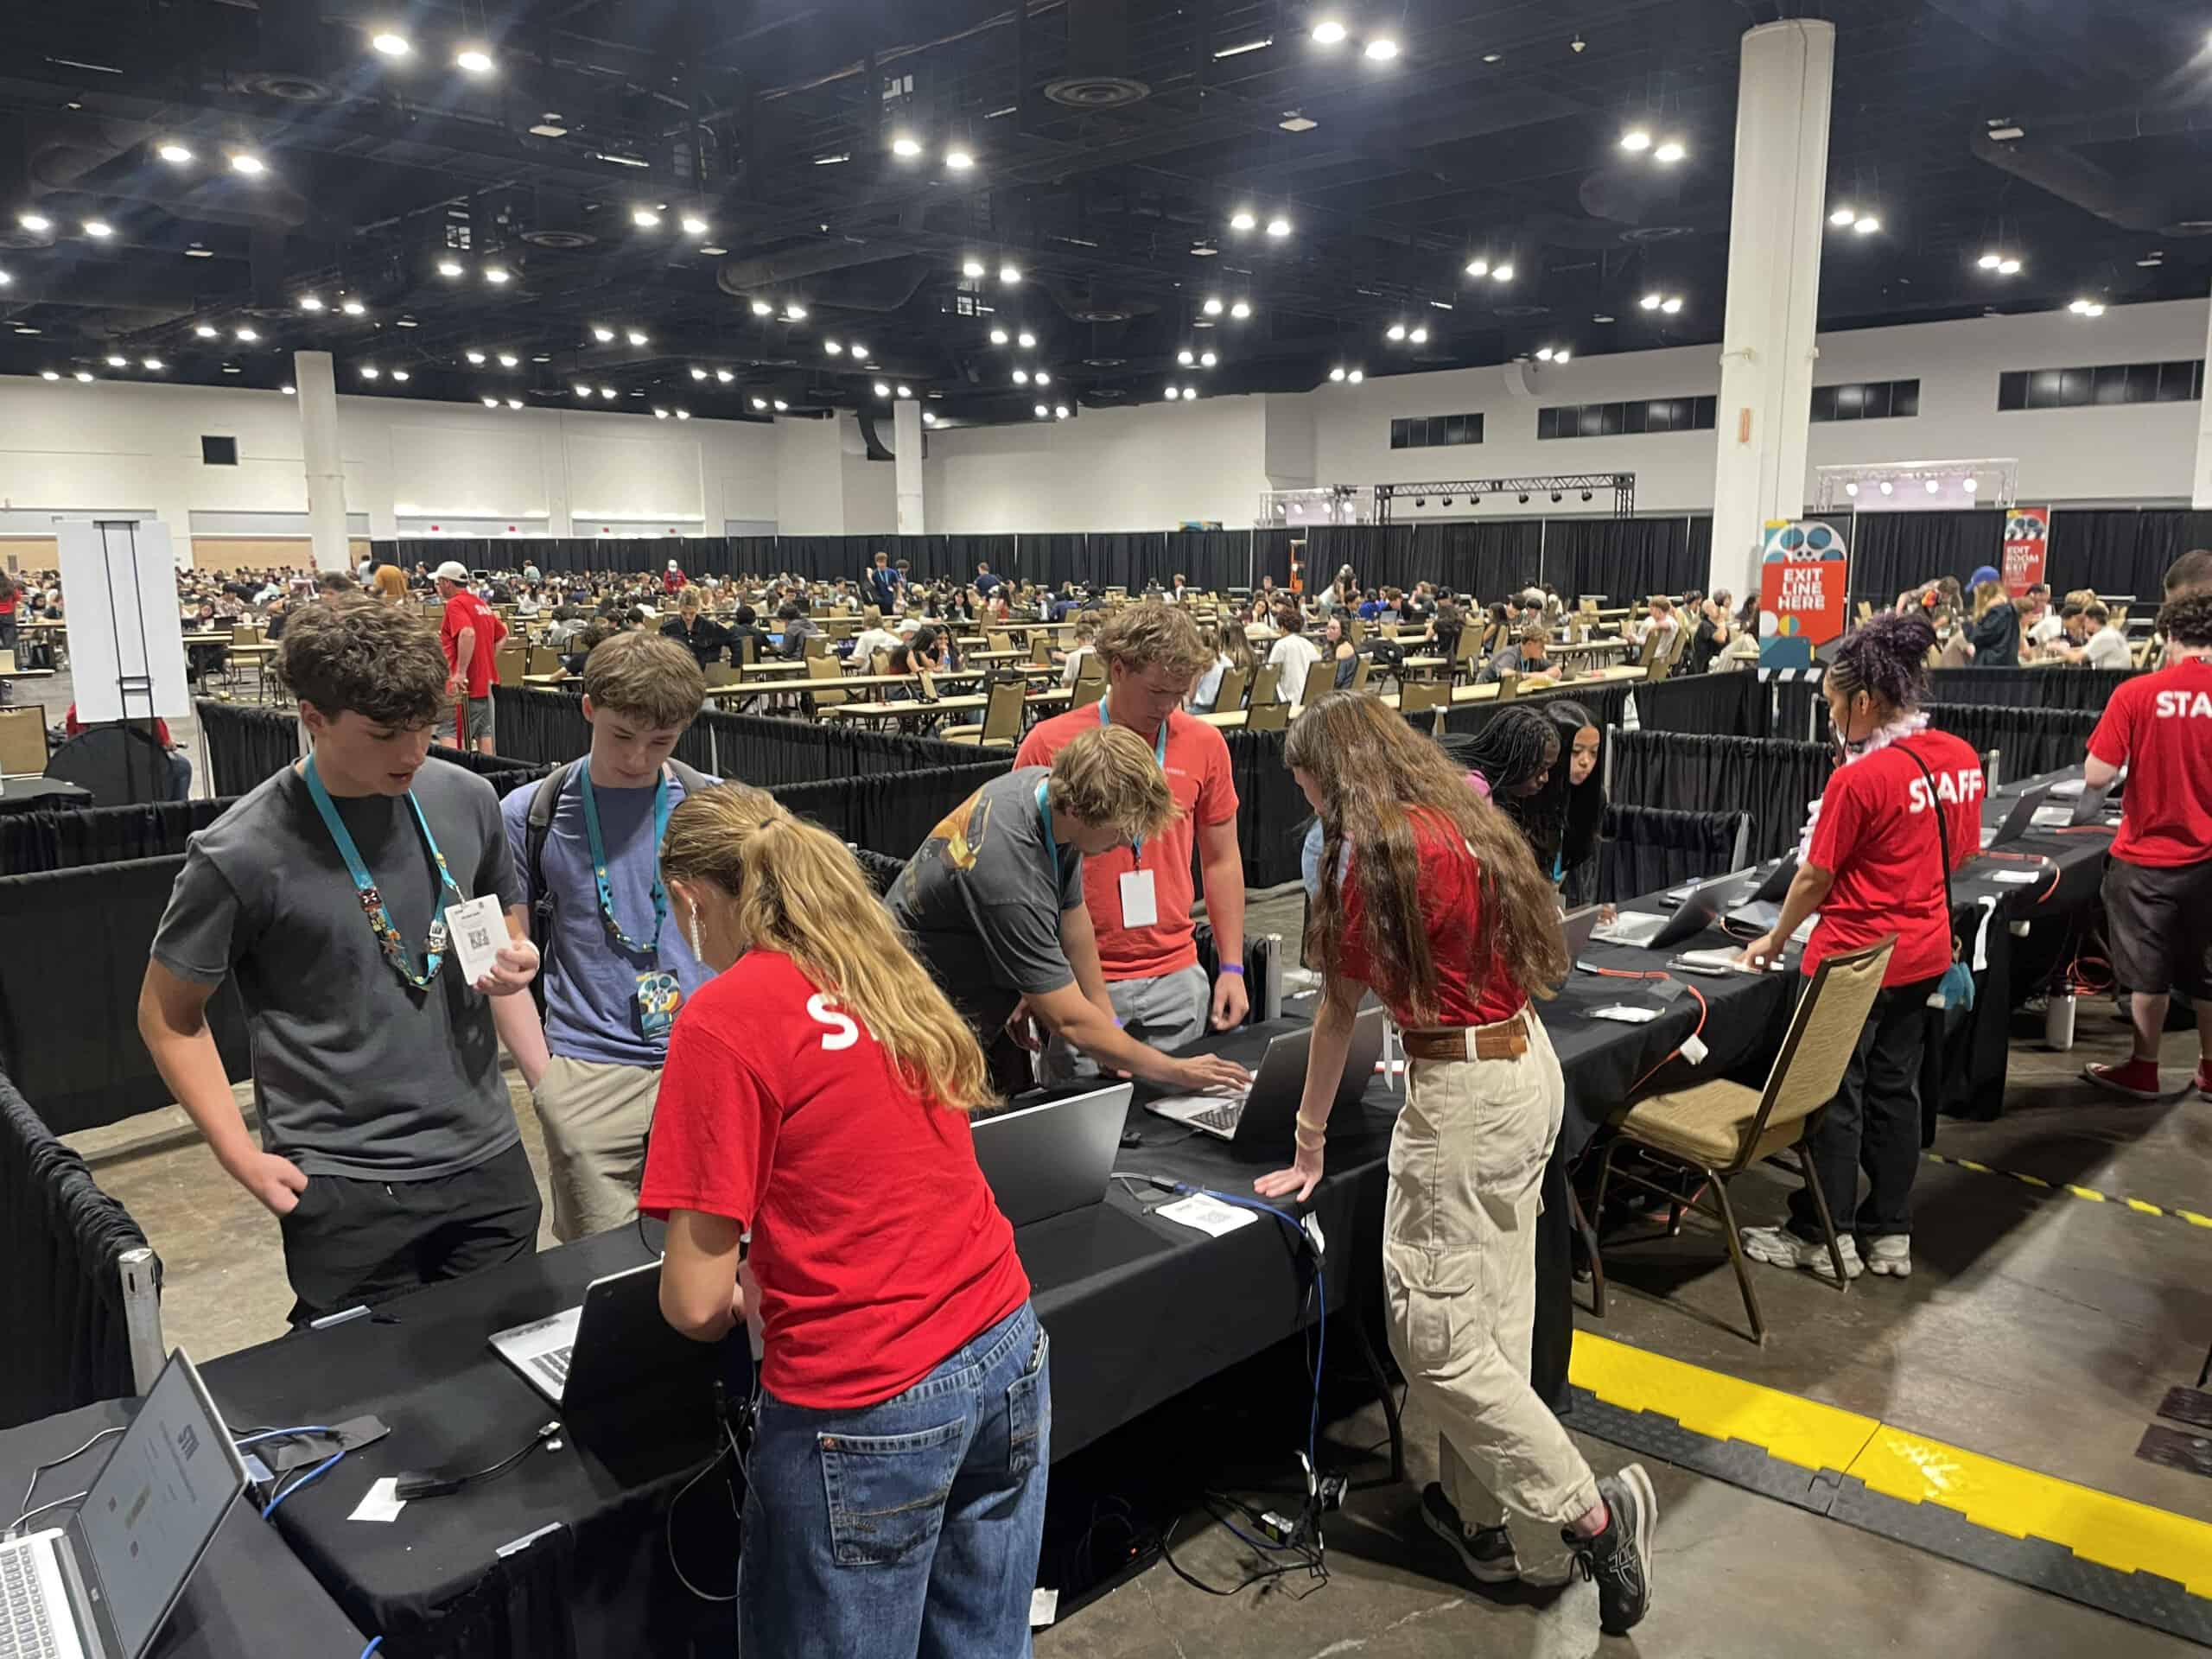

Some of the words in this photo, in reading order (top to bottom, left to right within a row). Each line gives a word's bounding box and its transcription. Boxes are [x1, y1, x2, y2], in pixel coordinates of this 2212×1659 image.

[1783, 568, 1823, 582] EXIT
[1783, 581, 1822, 595] LINE
[1778, 594, 1825, 610] HERE
[1909, 768, 1982, 814] STAFF
